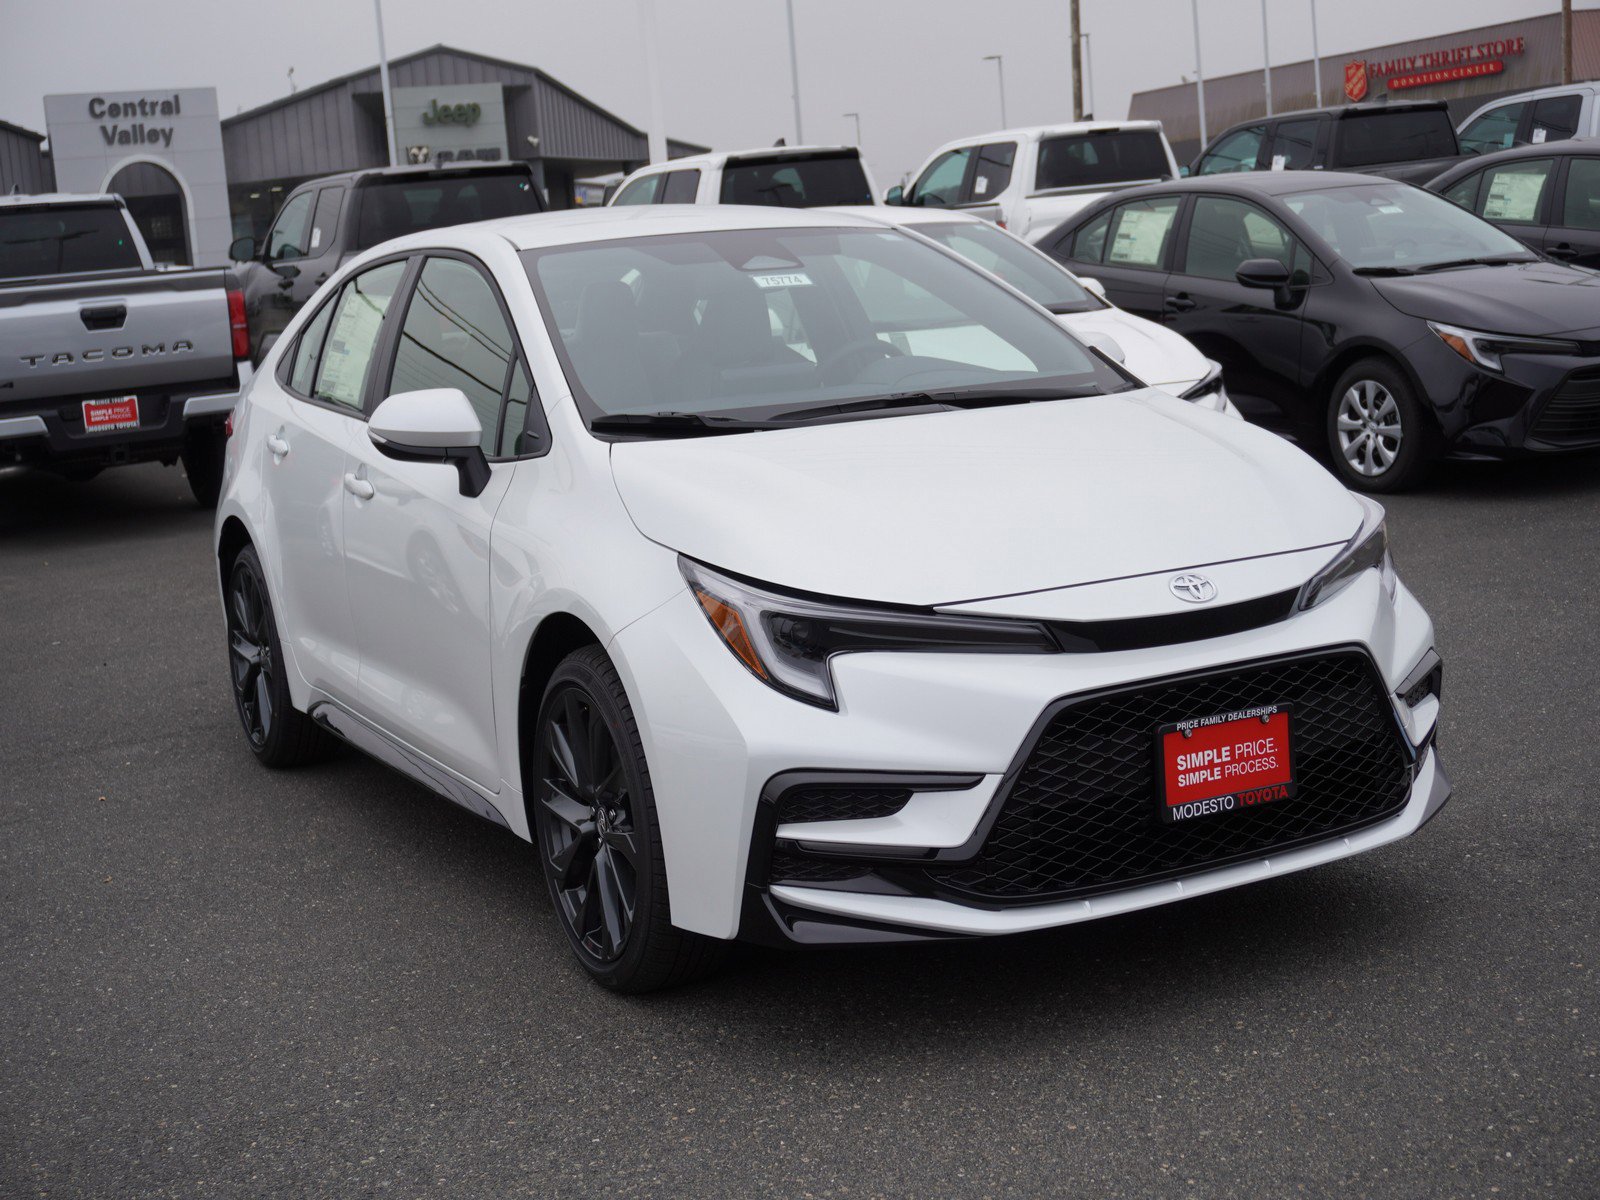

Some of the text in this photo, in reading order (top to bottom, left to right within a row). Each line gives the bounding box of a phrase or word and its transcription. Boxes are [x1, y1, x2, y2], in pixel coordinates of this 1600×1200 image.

[1368, 37, 1525, 79] FAMILY THRIFT STORE
[1393, 63, 1495, 88] DONATION CENTER
[88, 94, 181, 119] Central
[422, 99, 482, 127] Jeep
[100, 124, 174, 147] Valley
[761, 275, 803, 285] 75774
[19, 340, 194, 368] TACOMA
[1176, 706, 1278, 731] PRICE FAMILY DEALERSHIPS
[1177, 738, 1278, 771] SIMPLE PRICE.
[1178, 756, 1279, 787] SIMPLE PROCESS.
[1173, 785, 1289, 821] MODESTO TOYOTA
